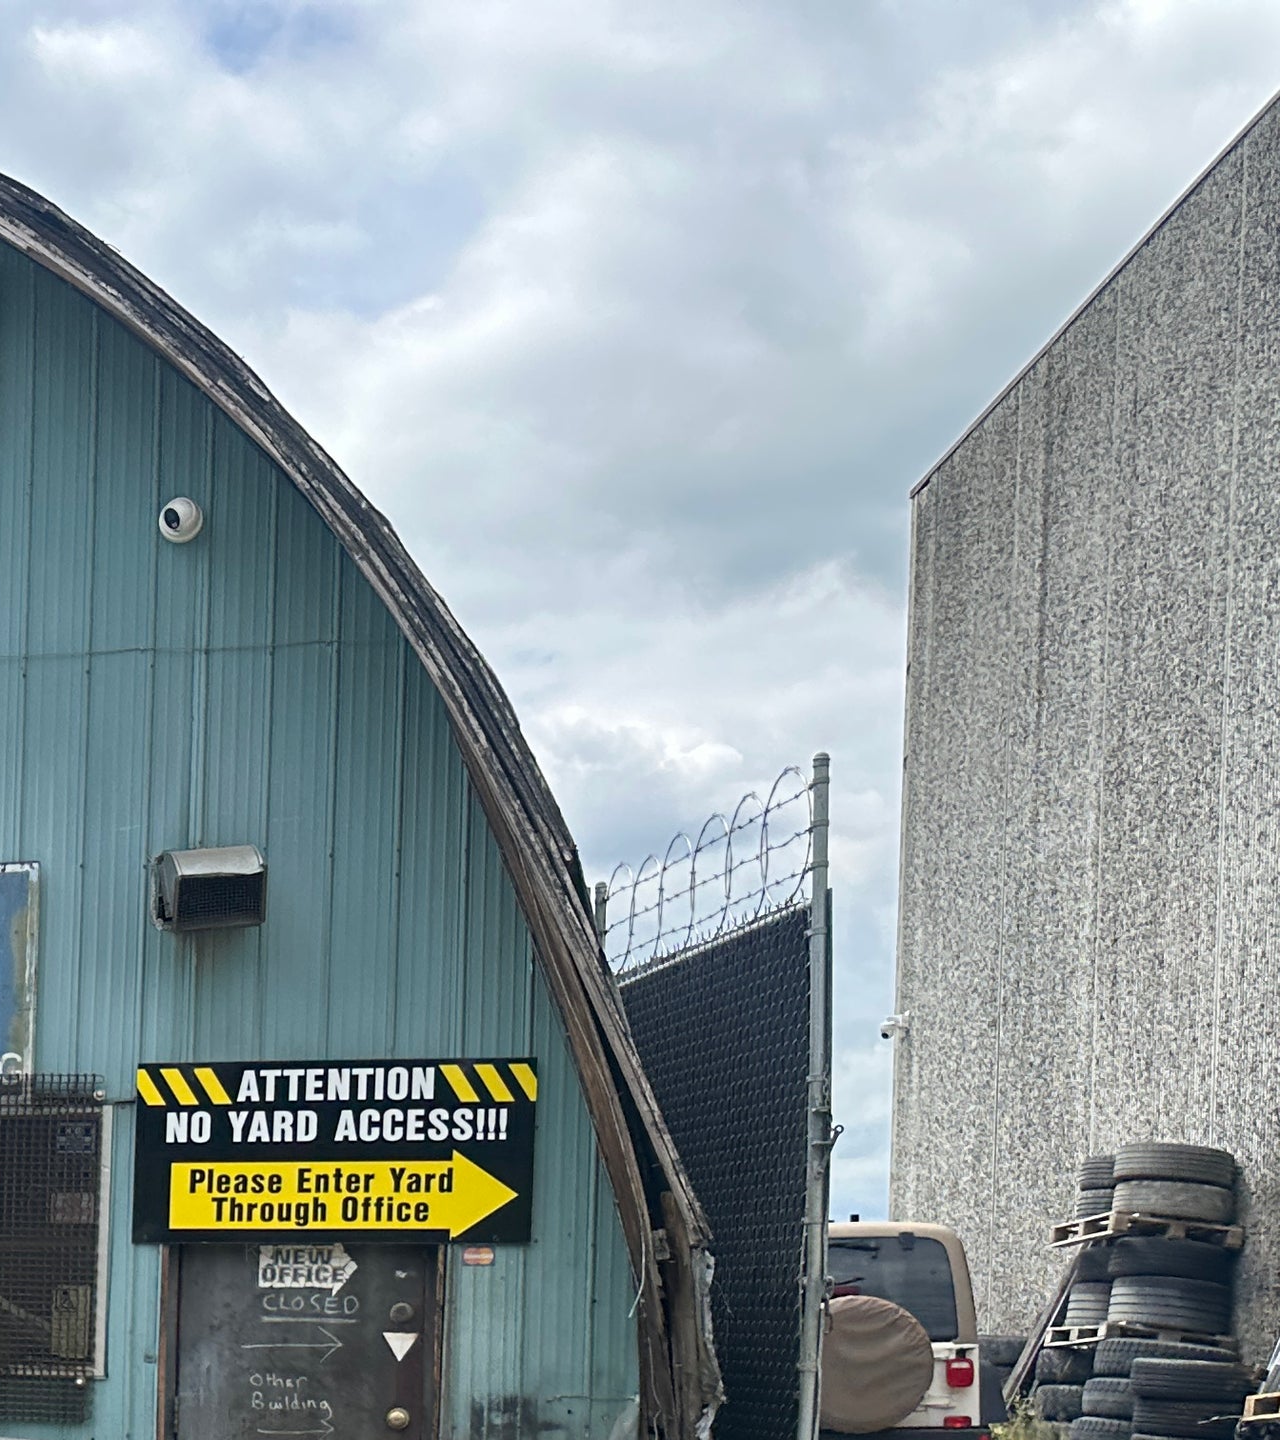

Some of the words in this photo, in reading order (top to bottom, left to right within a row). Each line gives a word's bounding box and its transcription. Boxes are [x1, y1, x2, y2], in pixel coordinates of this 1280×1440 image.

[236, 1066, 436, 1103] ATTENTION
[164, 1110, 212, 1144] NO
[228, 1109, 319, 1143] YARD
[333, 1107, 509, 1142] ACCESS!!!
[188, 1168, 283, 1195] Please
[296, 1167, 376, 1194] Enter
[388, 1167, 455, 1194] Yard
[211, 1197, 328, 1231] Through
[341, 1197, 430, 1223] Office
[274, 1247, 331, 1266] NEW
[262, 1264, 347, 1284] OFFICE
[262, 1293, 360, 1315] CLOSED
[249, 1372, 309, 1389] Other
